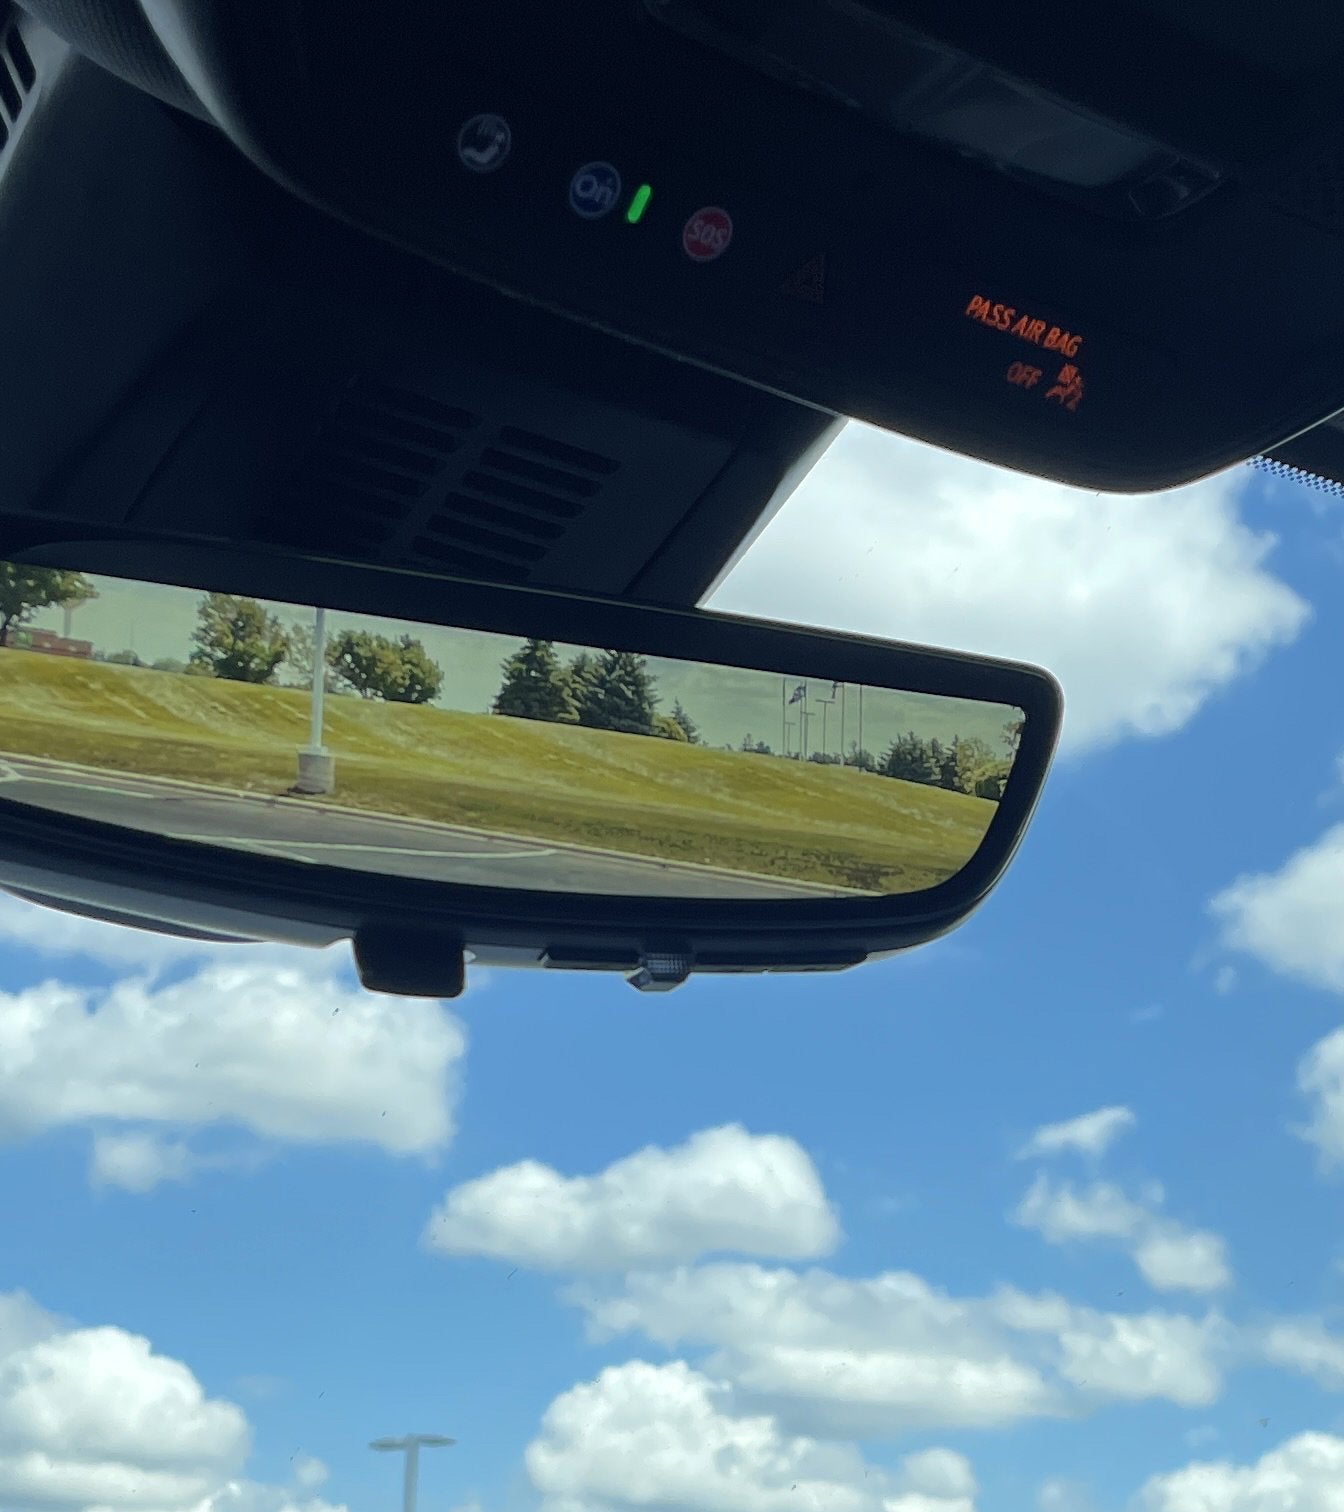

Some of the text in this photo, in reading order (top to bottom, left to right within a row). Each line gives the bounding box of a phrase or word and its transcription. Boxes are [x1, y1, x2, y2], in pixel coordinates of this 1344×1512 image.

[687, 219, 728, 249] SOS
[965, 294, 1084, 359] PASS AIR BAG
[1006, 361, 1043, 389] OFF
